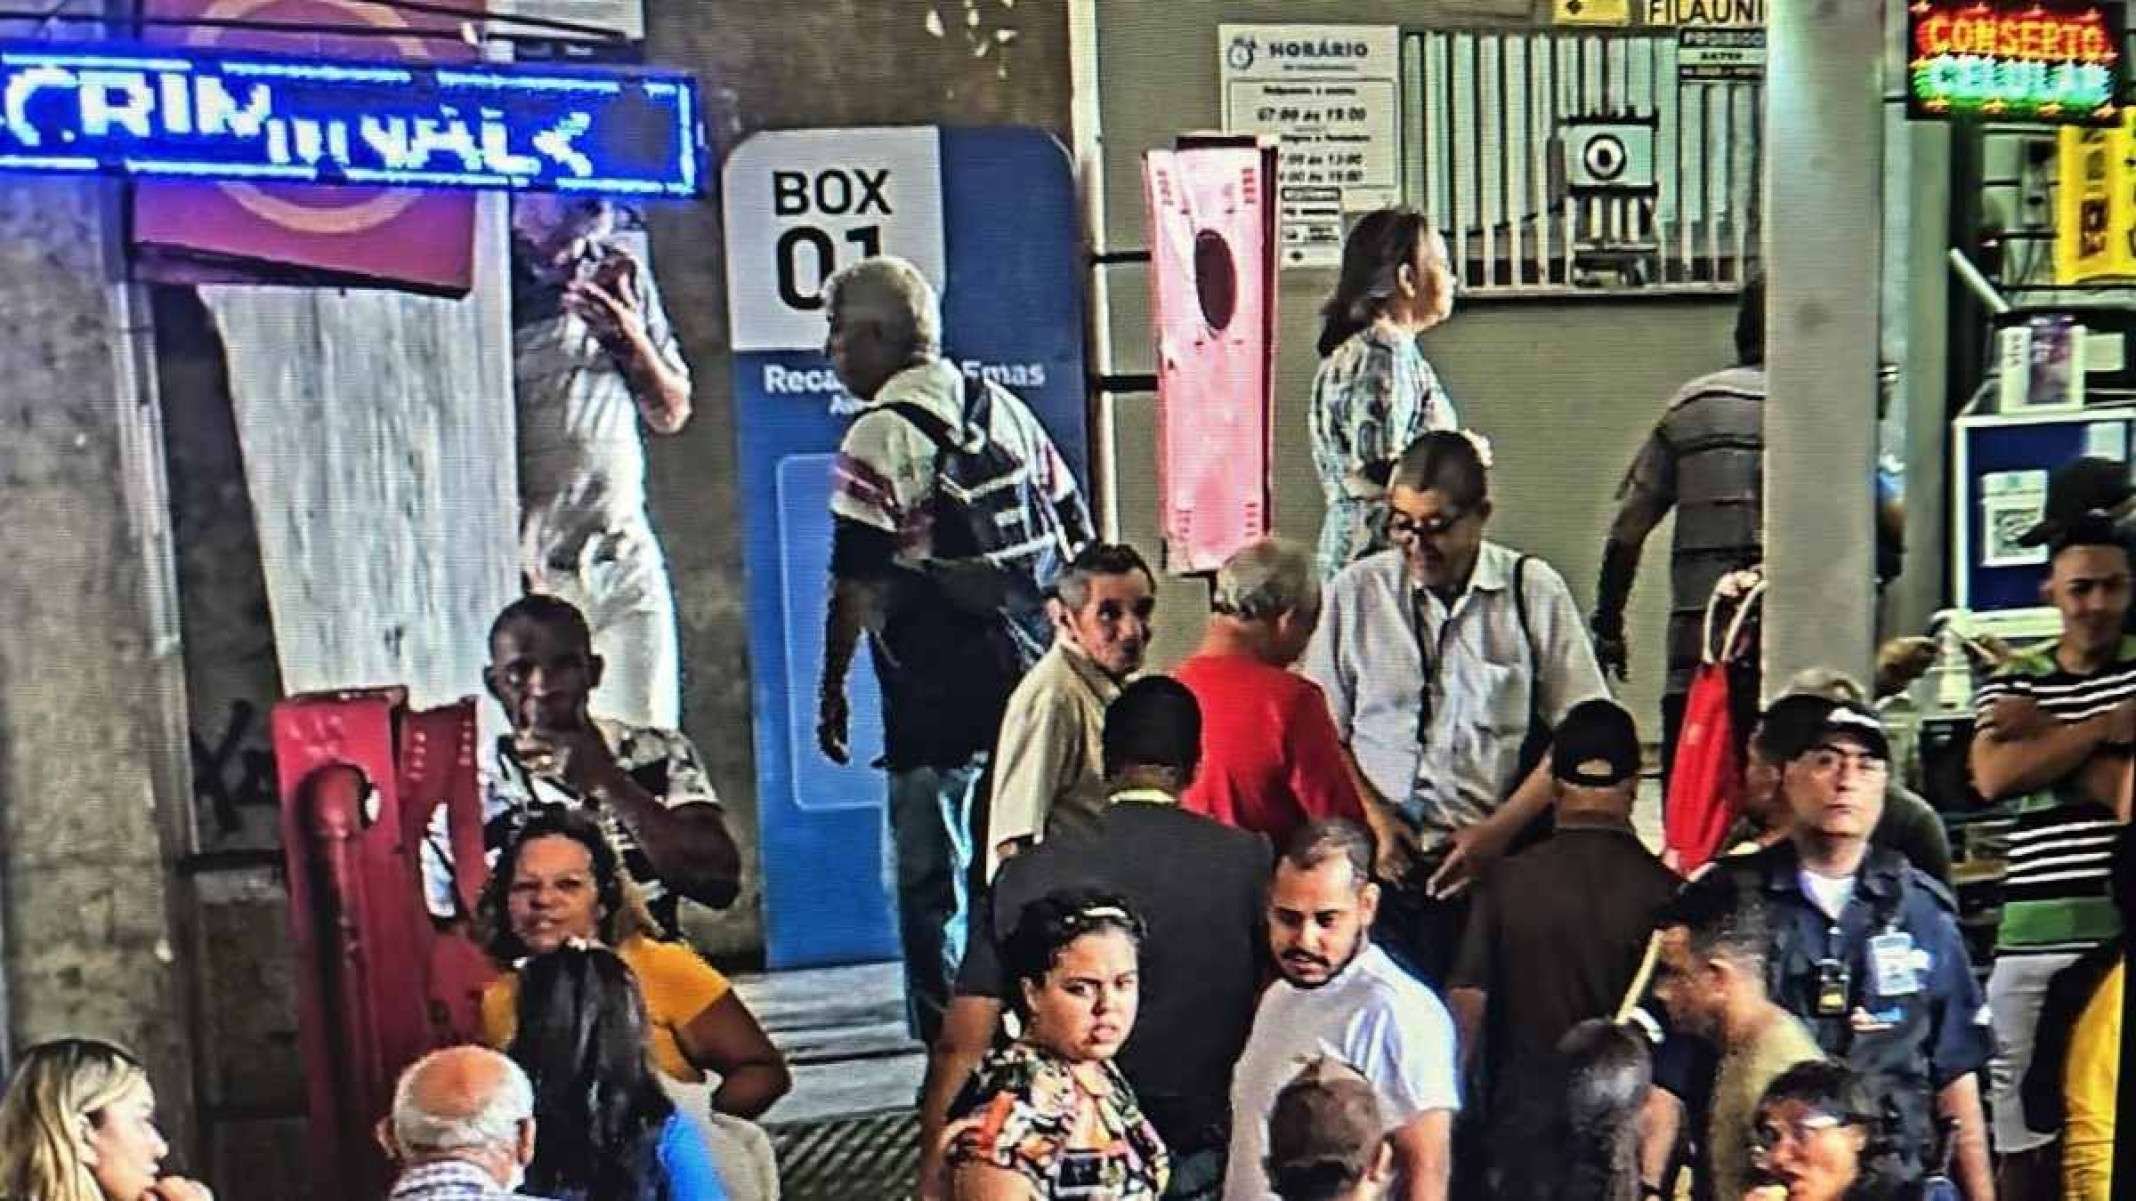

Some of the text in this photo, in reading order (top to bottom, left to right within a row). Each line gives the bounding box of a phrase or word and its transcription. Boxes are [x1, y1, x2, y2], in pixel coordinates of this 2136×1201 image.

[1269, 38, 1369, 58] HORÁRIO
[1920, 14, 2106, 61] CONSERTO
[772, 168, 892, 216] BOX
[763, 364, 847, 394] Reca
